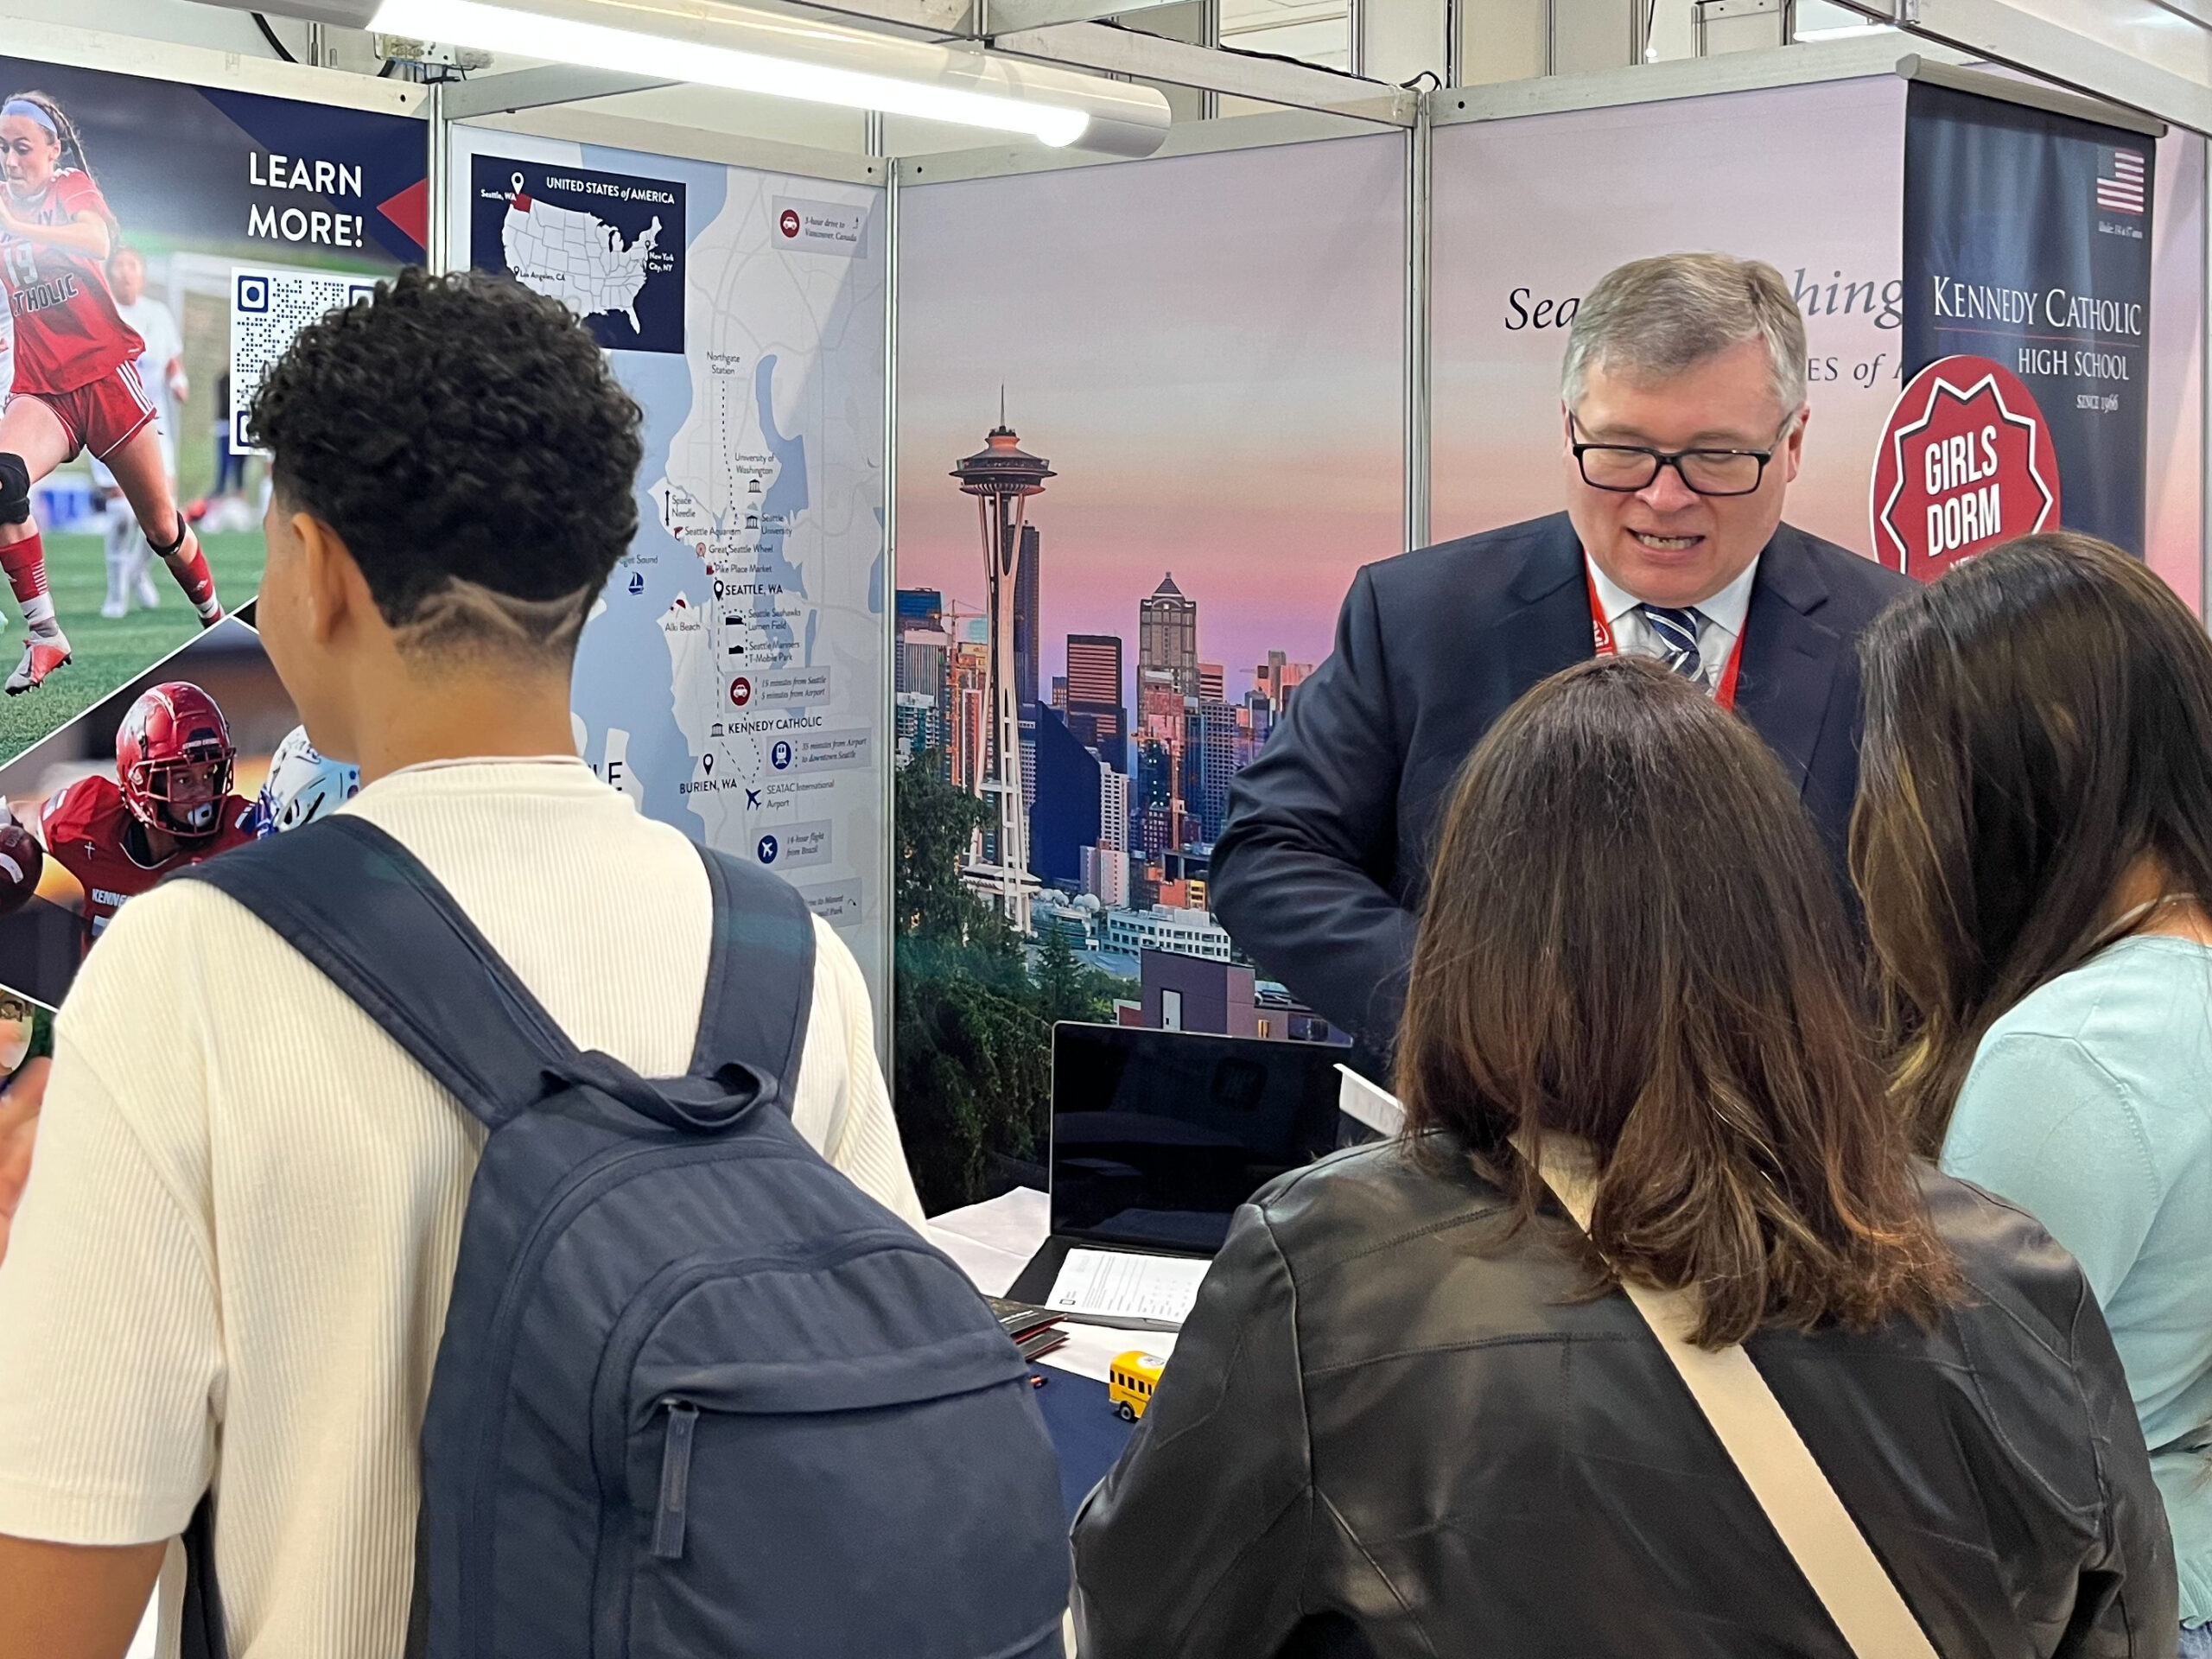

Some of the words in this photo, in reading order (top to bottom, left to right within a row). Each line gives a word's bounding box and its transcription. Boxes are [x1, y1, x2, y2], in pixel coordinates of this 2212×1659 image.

[249, 152, 362, 198] LEARN
[504, 191, 517, 201] WA
[546, 176, 584, 192] UNITED
[586, 181, 619, 197] STATES
[621, 188, 632, 201] of
[631, 189, 675, 205] AMERICA
[247, 204, 363, 248] MORE!
[13, 273, 79, 317] THOLIC
[1934, 276, 2037, 326] KENNEDY
[2045, 289, 2142, 336] CATHOLIC
[707, 351, 741, 365] Northgate
[2018, 347, 2069, 376] HIGH
[2075, 351, 2129, 380] SCHOOL
[712, 365, 734, 375] Station
[1853, 353, 1886, 389] of
[2076, 394, 2099, 410] SINCE
[735, 453, 766, 465] University
[768, 453, 774, 461] of
[1925, 425, 1998, 495] GIRLS
[736, 465, 773, 478] Washington
[671, 495, 692, 508] Space
[672, 508, 696, 518] Needle
[1927, 483, 2001, 557] DORM
[685, 526, 708, 536] Seattle
[709, 544, 728, 554] Great
[728, 544, 752, 553] Seattle
[753, 543, 773, 553] Wheel
[620, 556, 635, 568] uget
[637, 555, 658, 564] Sound
[715, 564, 728, 573] Pike
[731, 564, 747, 574] Place
[749, 564, 772, 573] Market
[725, 585, 766, 596] SEATTLE,
[768, 584, 783, 594] WA
[680, 621, 701, 631] Beach
[748, 622, 770, 631] Lumen
[772, 620, 787, 630] Field
[791, 677, 806, 690] from
[789, 690, 804, 701] from
[804, 689, 825, 698] Airport
[728, 720, 774, 734] KENNEDY
[776, 716, 822, 729] CATHOLIC
[846, 738, 867, 748] Airport
[679, 779, 720, 794] BURIEN,
[721, 778, 737, 790] WA
[797, 779, 835, 791] International
[766, 799, 789, 810] Airport
[92, 888, 127, 907] KENNE
